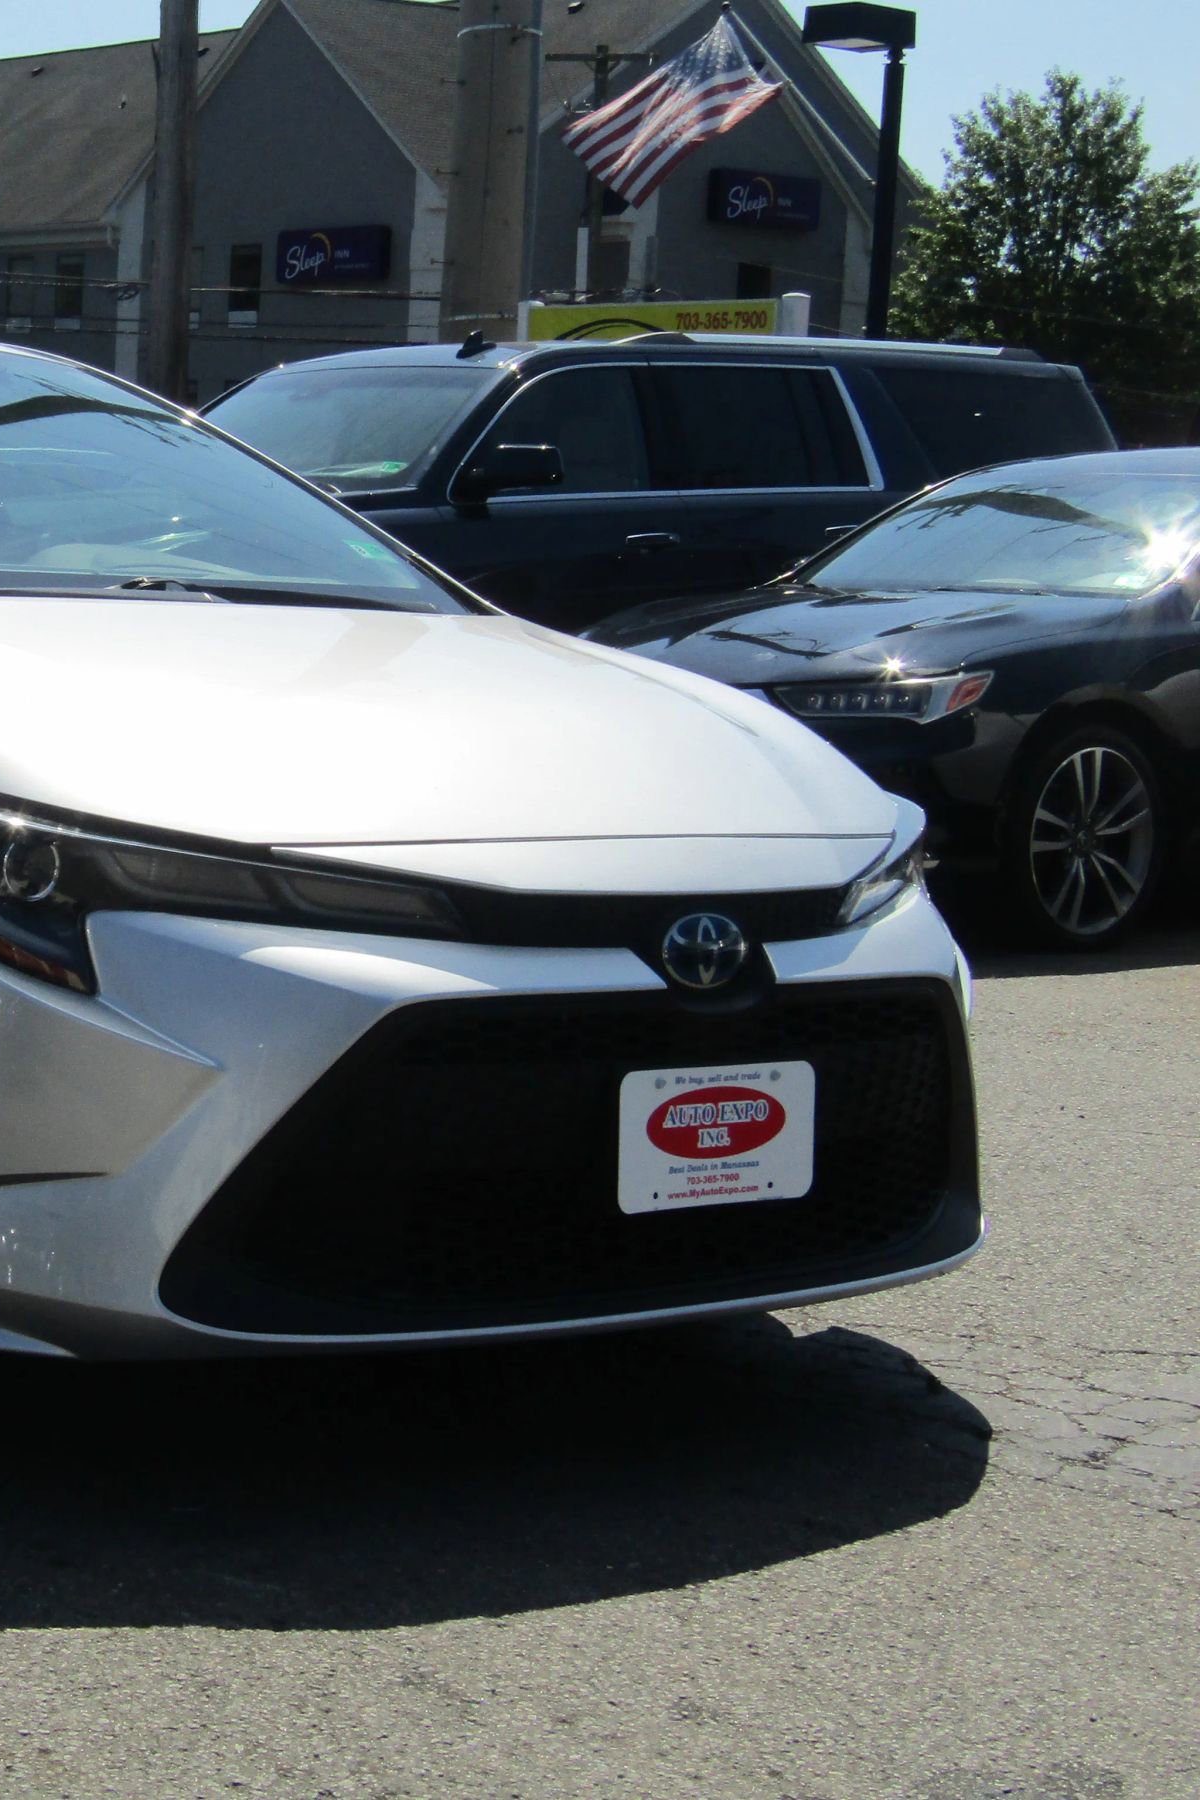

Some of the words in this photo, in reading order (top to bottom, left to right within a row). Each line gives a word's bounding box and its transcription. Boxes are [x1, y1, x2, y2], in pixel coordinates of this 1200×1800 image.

[726, 185, 768, 219] Sleep
[285, 245, 326, 279] Sleep
[675, 310, 768, 331] 703-365-7900
[675, 1076, 686, 1085] We
[707, 1074, 722, 1083] sell
[723, 1073, 739, 1082] and
[741, 1071, 761, 1081] trade
[663, 1103, 716, 1128] AUTO
[718, 1099, 769, 1124] EXPO
[697, 1128, 731, 1148] INC.
[668, 1166, 685, 1174] Best
[687, 1164, 708, 1173] Deals
[710, 1162, 718, 1171] in
[720, 1160, 760, 1170] Manassas
[686, 1173, 740, 1185] 703-365-7900
[667, 1185, 759, 1200] www.MyAutoExpo.com
